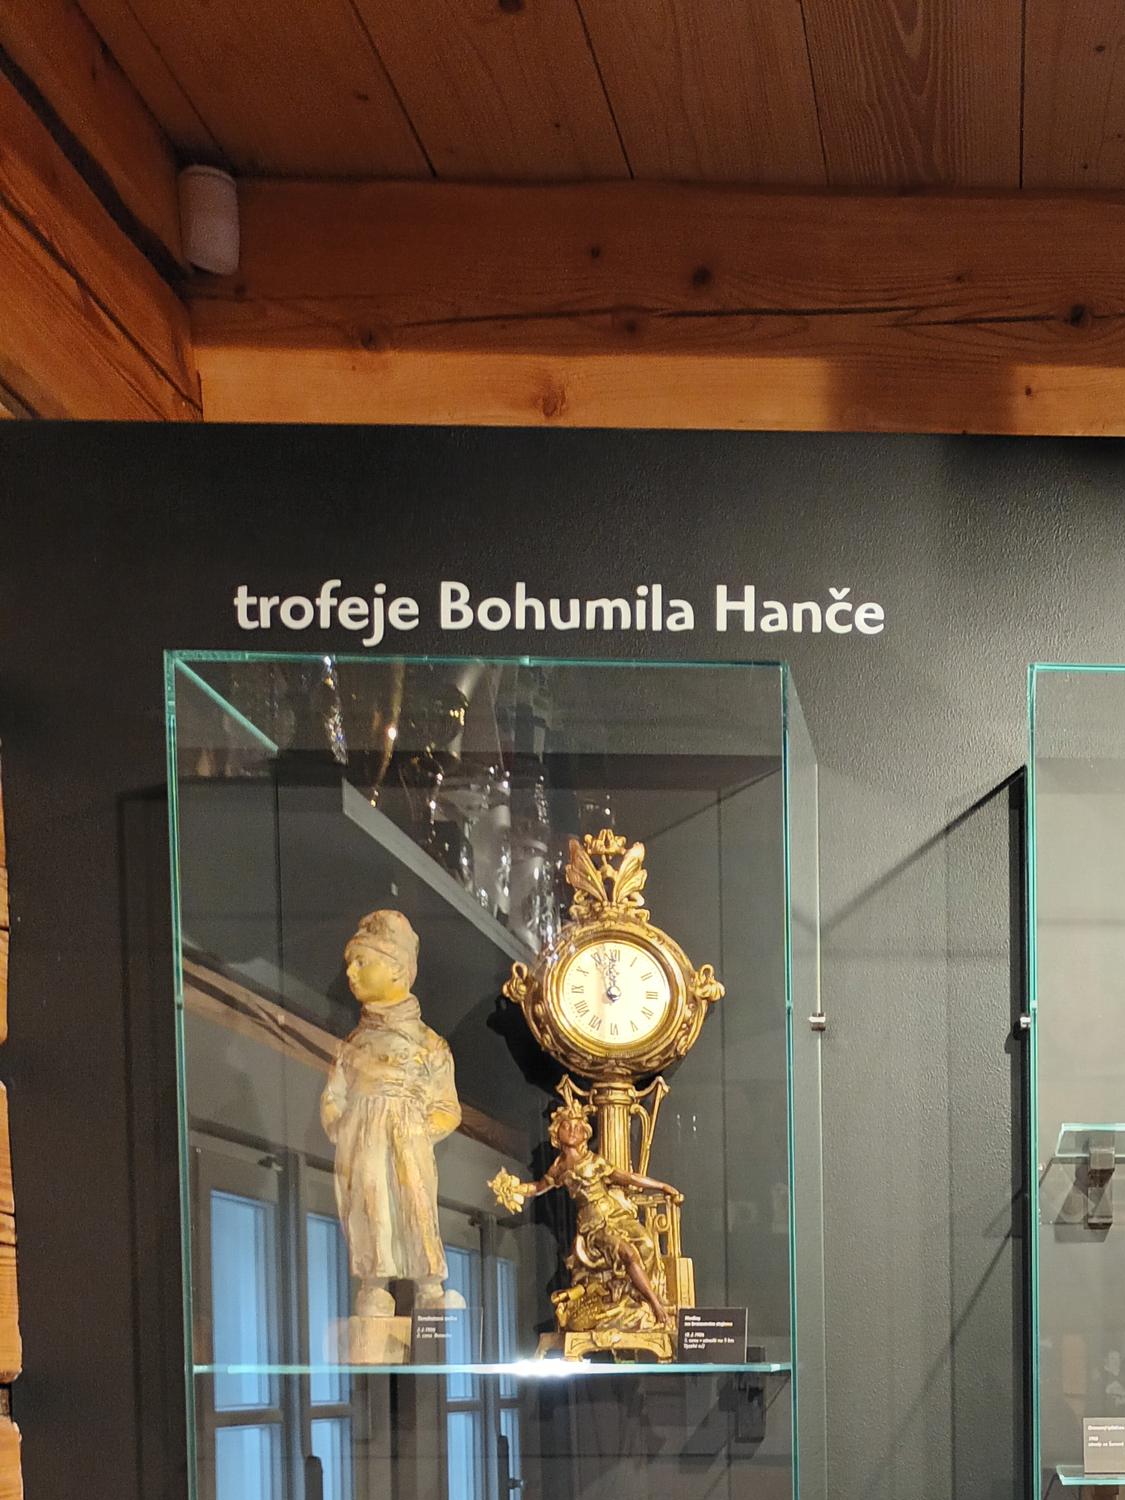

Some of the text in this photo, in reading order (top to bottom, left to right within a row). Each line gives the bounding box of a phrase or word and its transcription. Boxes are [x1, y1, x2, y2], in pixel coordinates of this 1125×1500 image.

[233, 579, 886, 647] trofeje Bohumila Hanče
